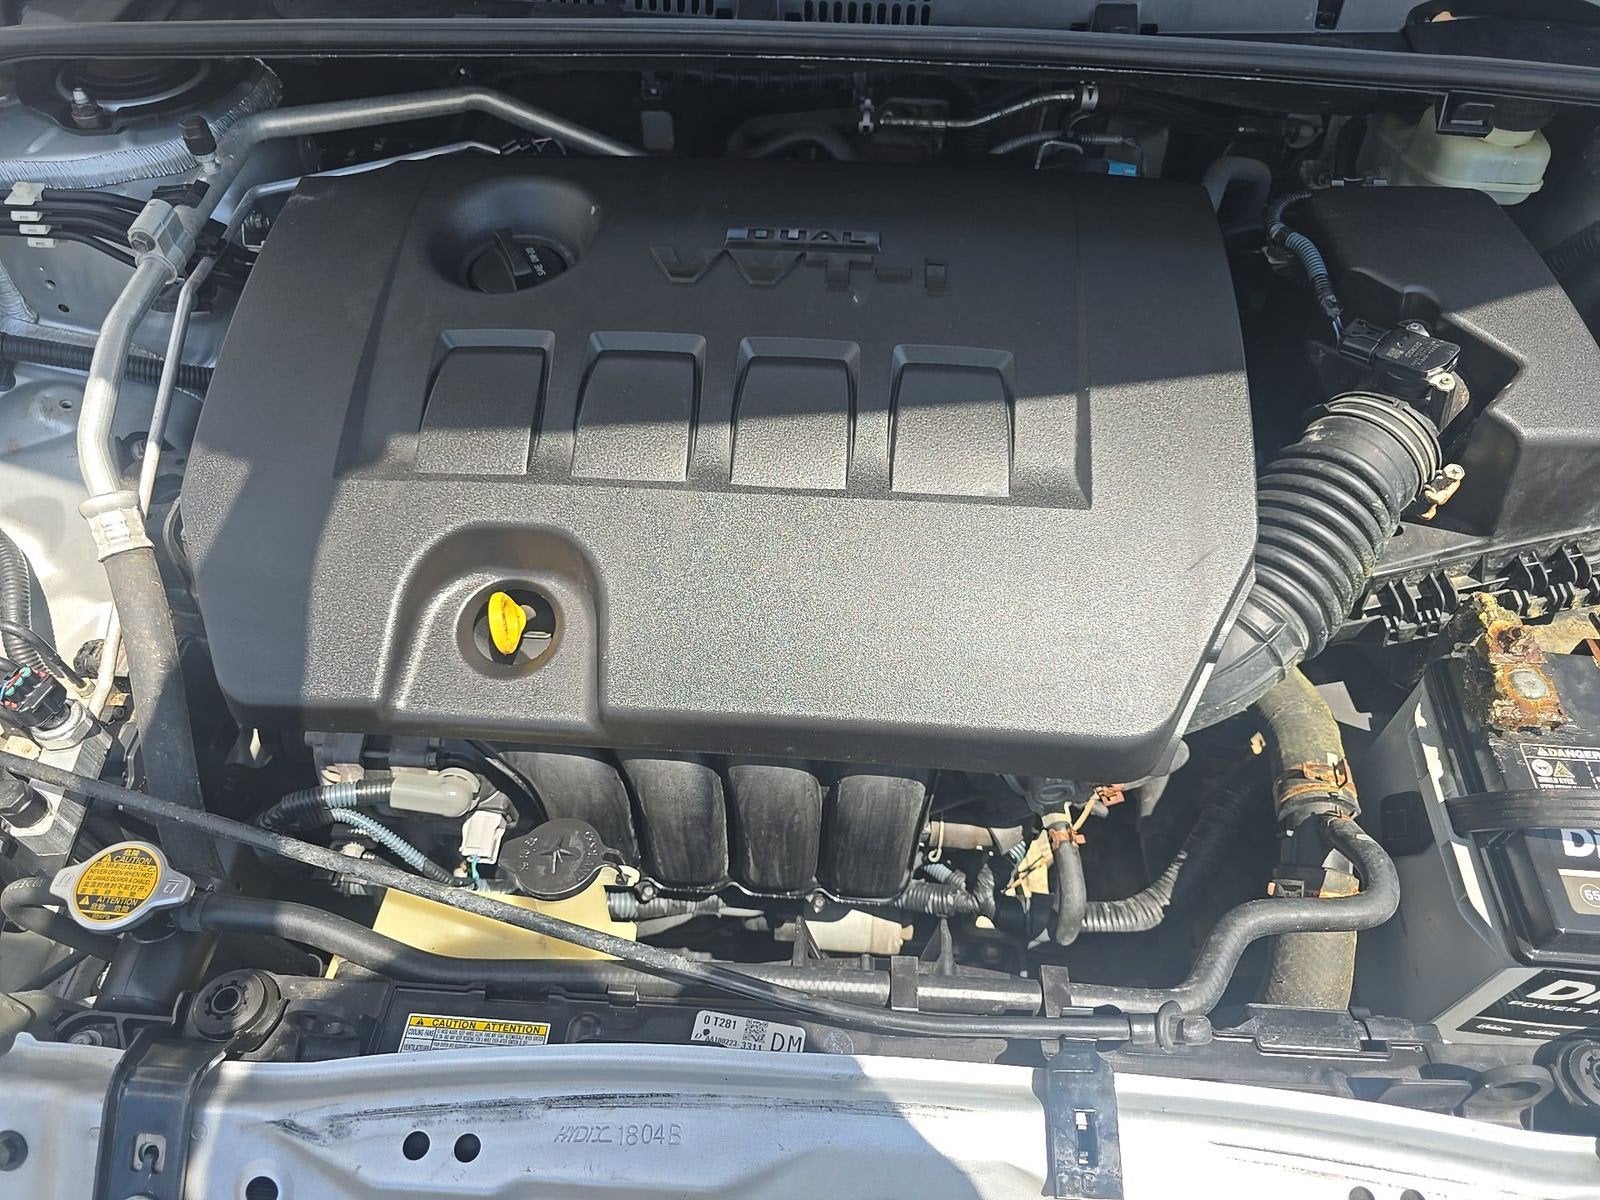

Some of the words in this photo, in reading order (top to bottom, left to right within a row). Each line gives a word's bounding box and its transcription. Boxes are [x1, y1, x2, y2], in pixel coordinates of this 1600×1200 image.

[1547, 748, 1600, 759] DANGER
[113, 856, 153, 865] CAUTION
[96, 896, 138, 906] ATTENTION
[1507, 1000, 1582, 1013] POWER
[431, 1018, 477, 1029] CAUTION
[483, 1022, 541, 1034] ATTENTION
[713, 1016, 737, 1030] T281
[770, 1031, 803, 1053] DM
